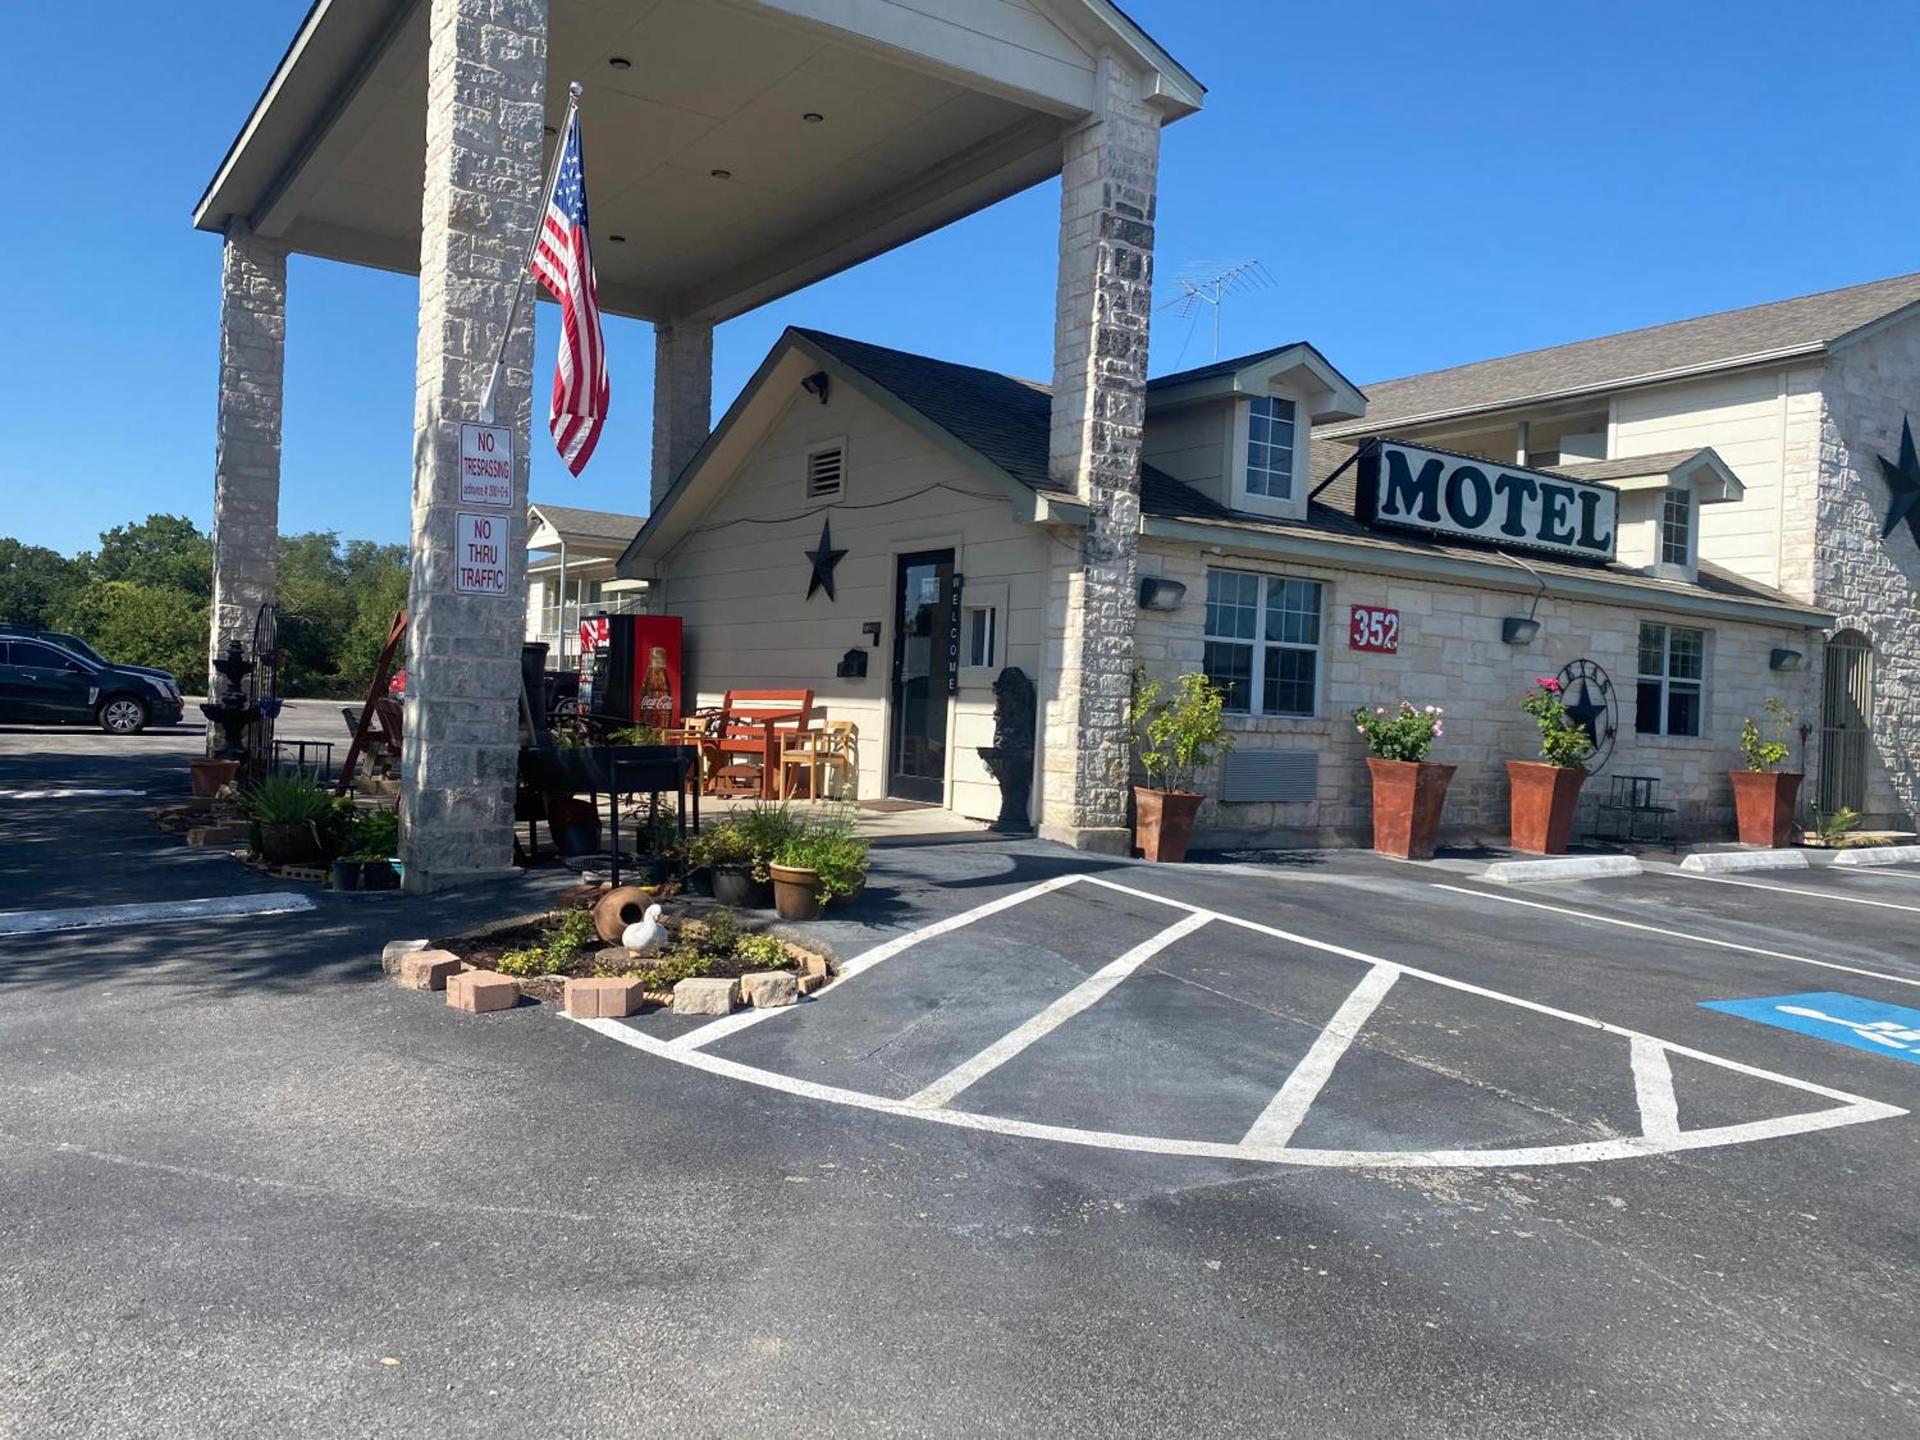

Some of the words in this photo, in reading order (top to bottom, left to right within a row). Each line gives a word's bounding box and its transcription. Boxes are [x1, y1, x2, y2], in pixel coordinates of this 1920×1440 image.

[478, 432, 495, 452] NO
[464, 457, 509, 480] TRESPASSING
[1381, 450, 1611, 551] MOTEL
[474, 519, 491, 540] NO
[468, 543, 498, 565] THRU
[461, 568, 504, 589] TRAFFIC
[949, 577, 961, 690] WELCOME
[1354, 609, 1398, 649] 352
